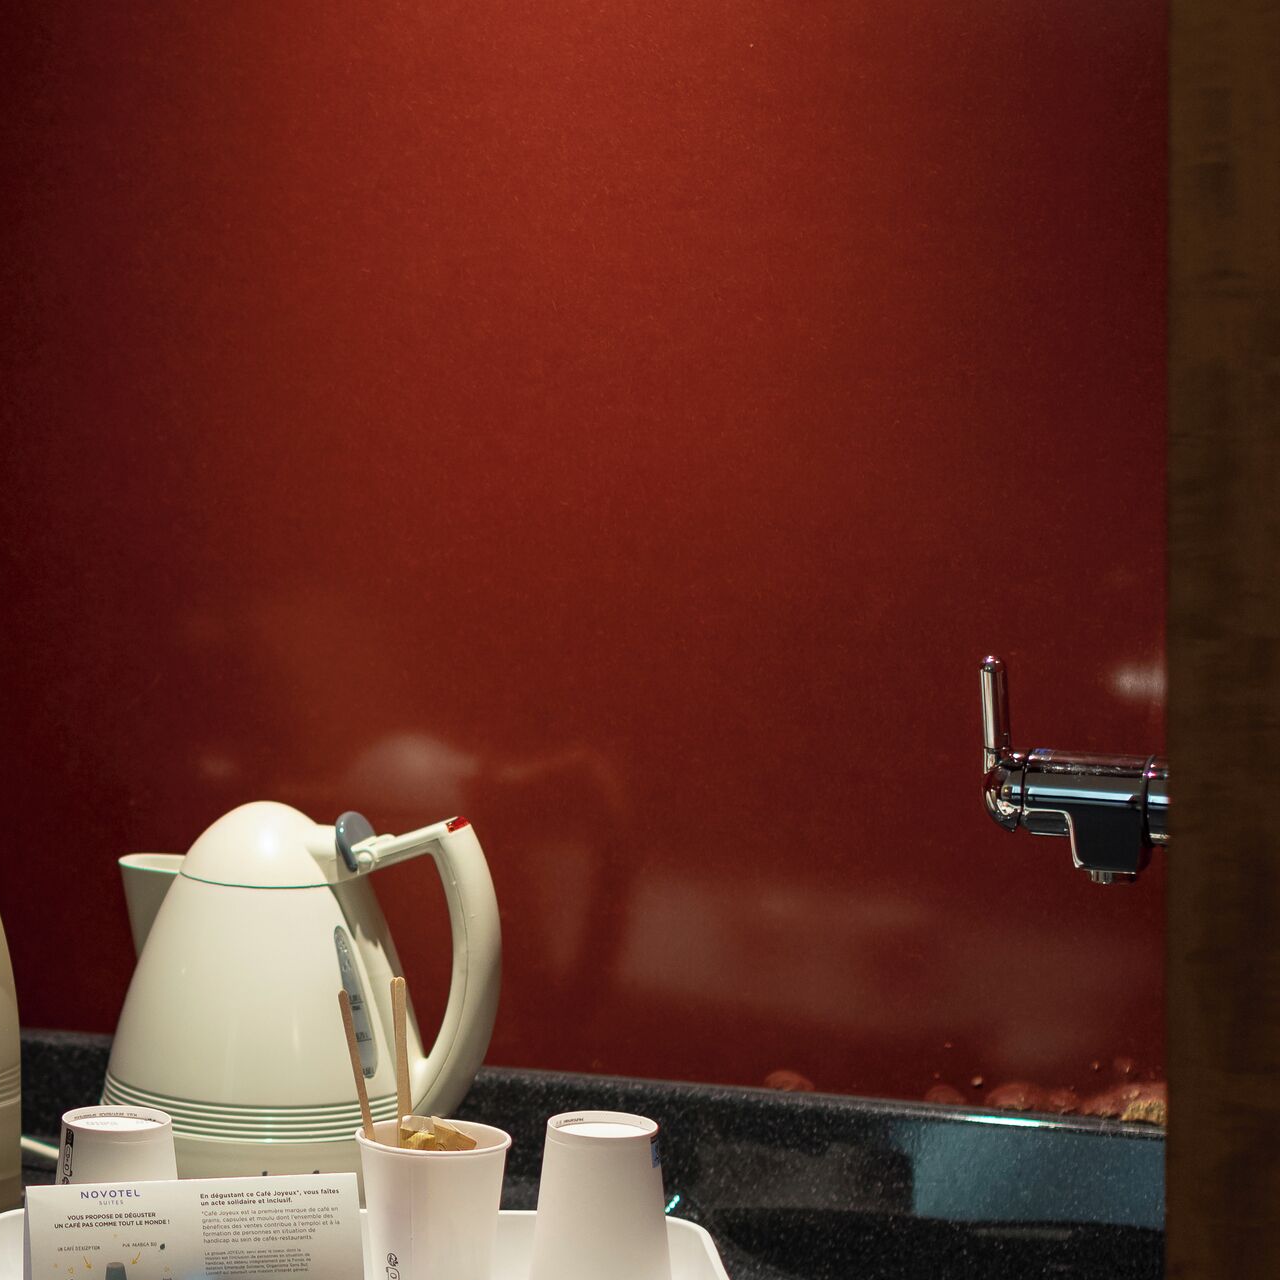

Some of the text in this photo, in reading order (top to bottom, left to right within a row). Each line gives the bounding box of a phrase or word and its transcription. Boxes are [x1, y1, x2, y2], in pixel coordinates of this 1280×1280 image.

[80, 1189, 141, 1199] NOVOTEL
[210, 1192, 244, 1200] dégustant
[124, 1211, 156, 1219] DÉGUSTER
